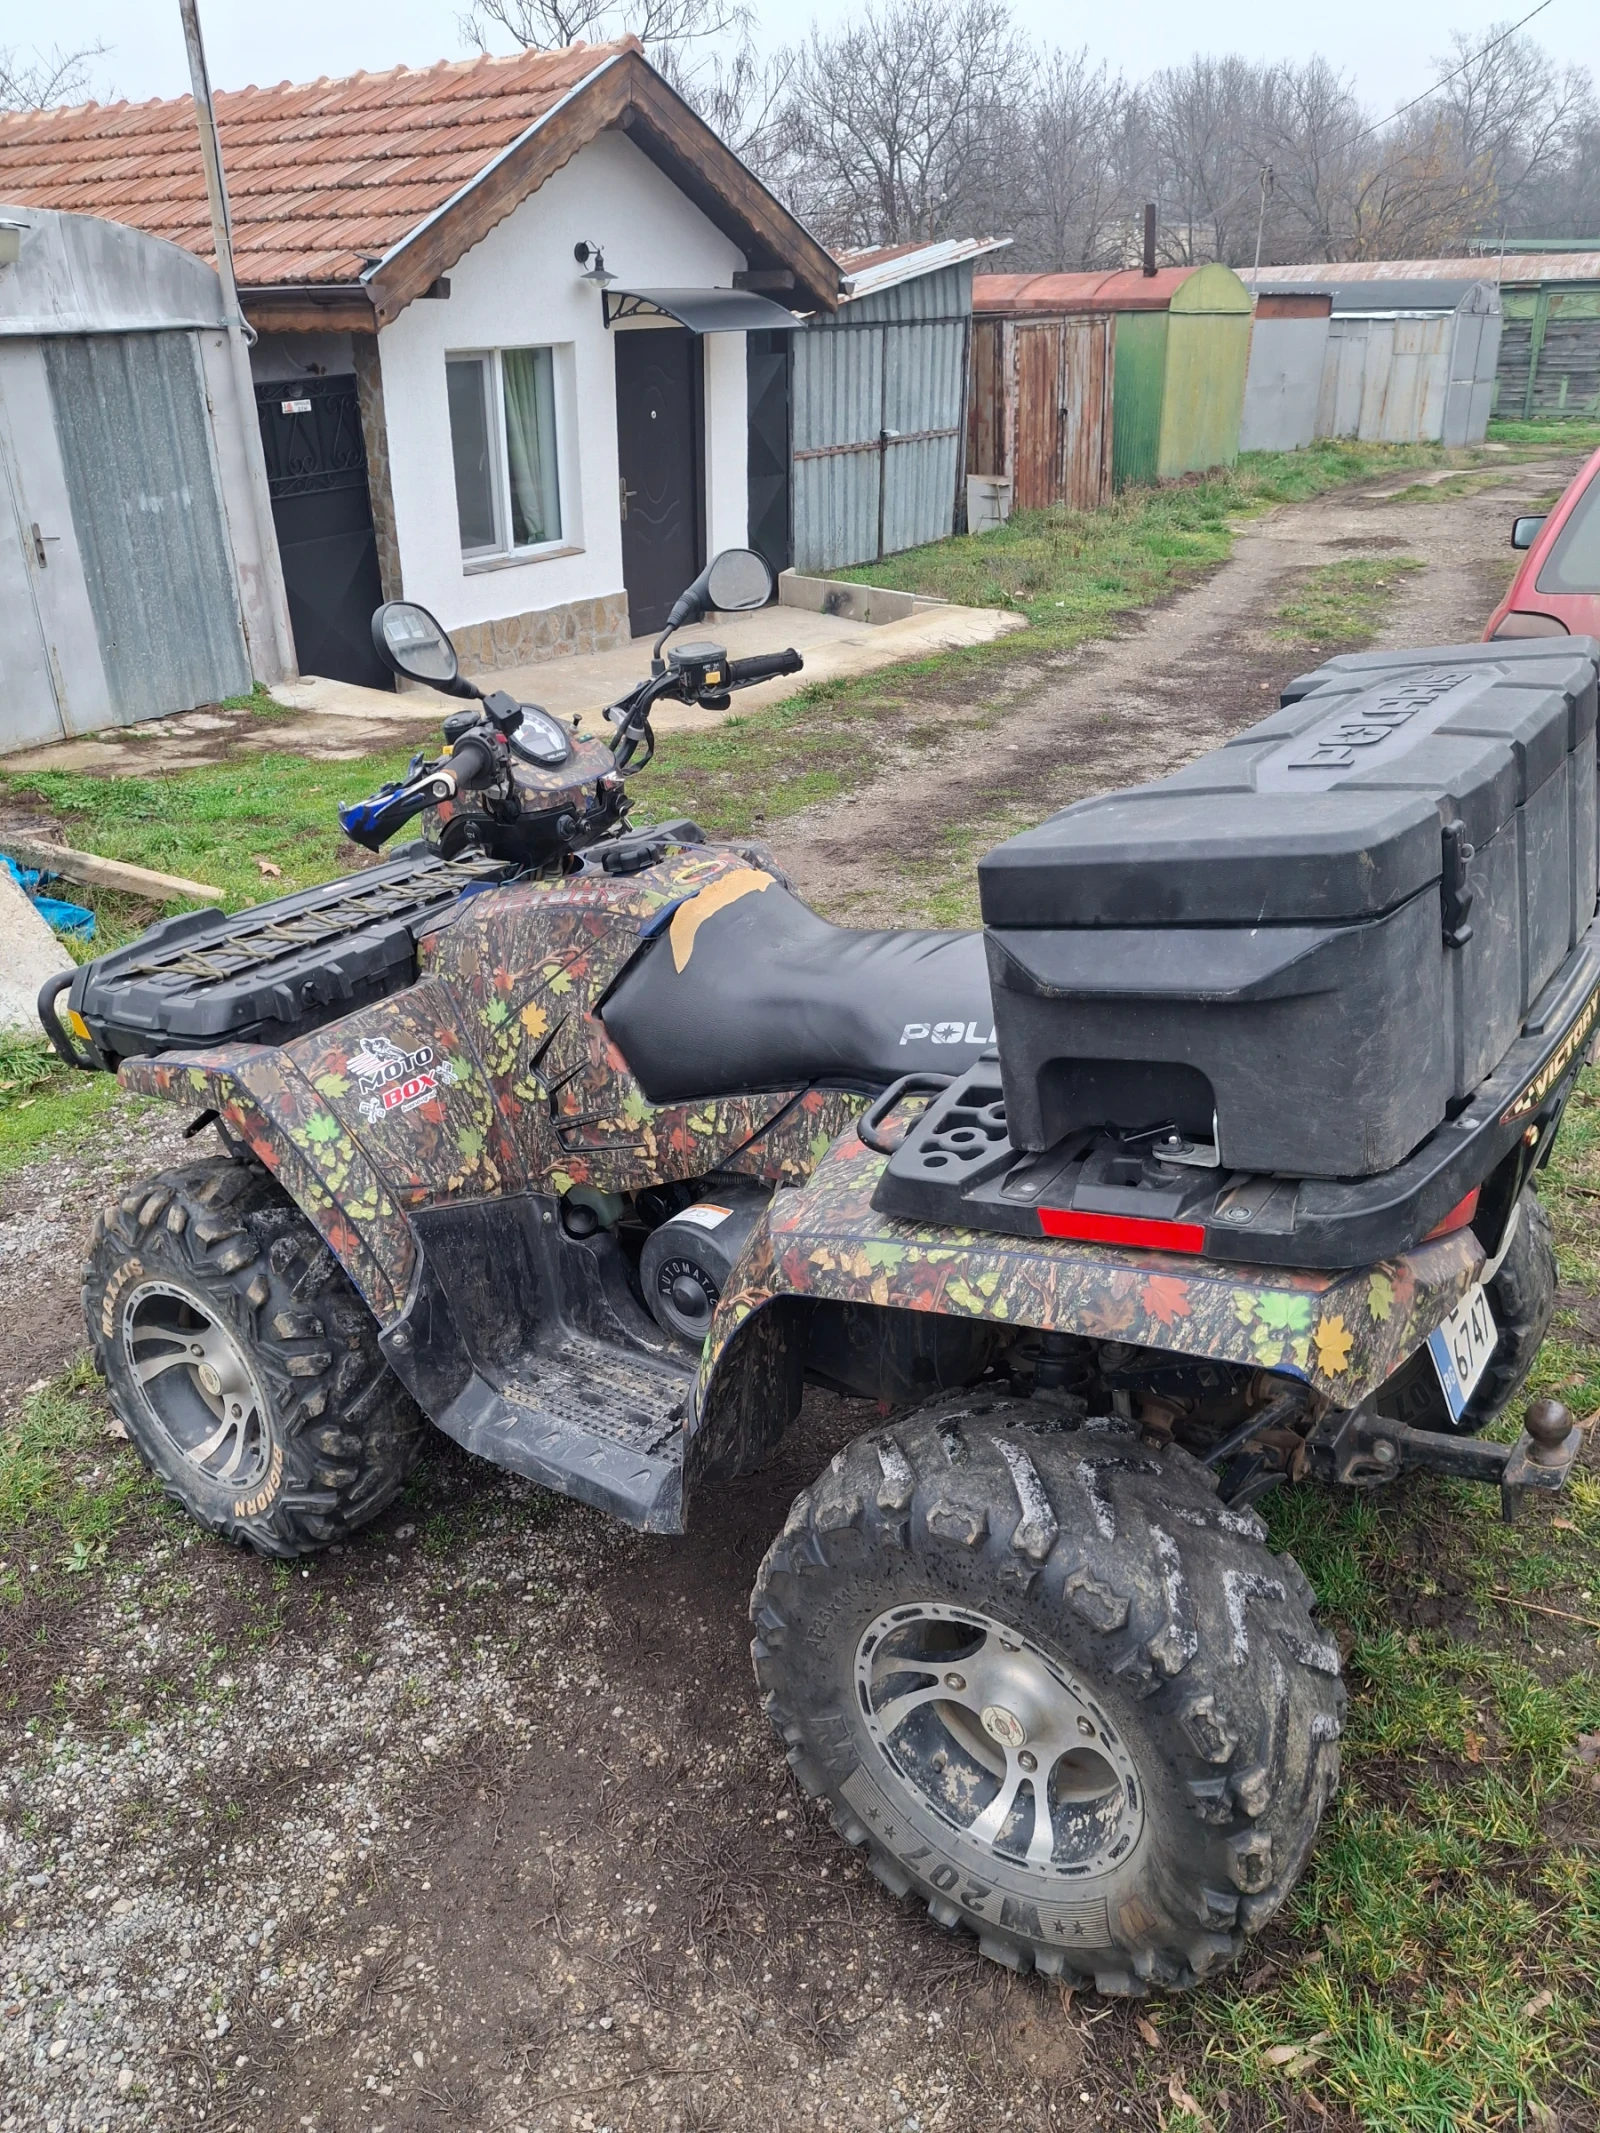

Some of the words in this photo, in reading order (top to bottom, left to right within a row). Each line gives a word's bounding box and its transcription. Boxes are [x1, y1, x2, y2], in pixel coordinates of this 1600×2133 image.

[1288, 674, 1472, 770] POLARIS
[474, 887, 634, 915] VICTORY
[359, 1046, 434, 1094] MOTO
[1533, 987, 1600, 1100] VICTORY
[383, 1069, 437, 1109] BOX
[102, 1257, 144, 1339] MAXXIS
[662, 1261, 719, 1306] AUTOMATIC
[1454, 1291, 1489, 1381] 6747
[1443, 1365, 1456, 1393] BG
[235, 1441, 283, 1517] BIGHORN
